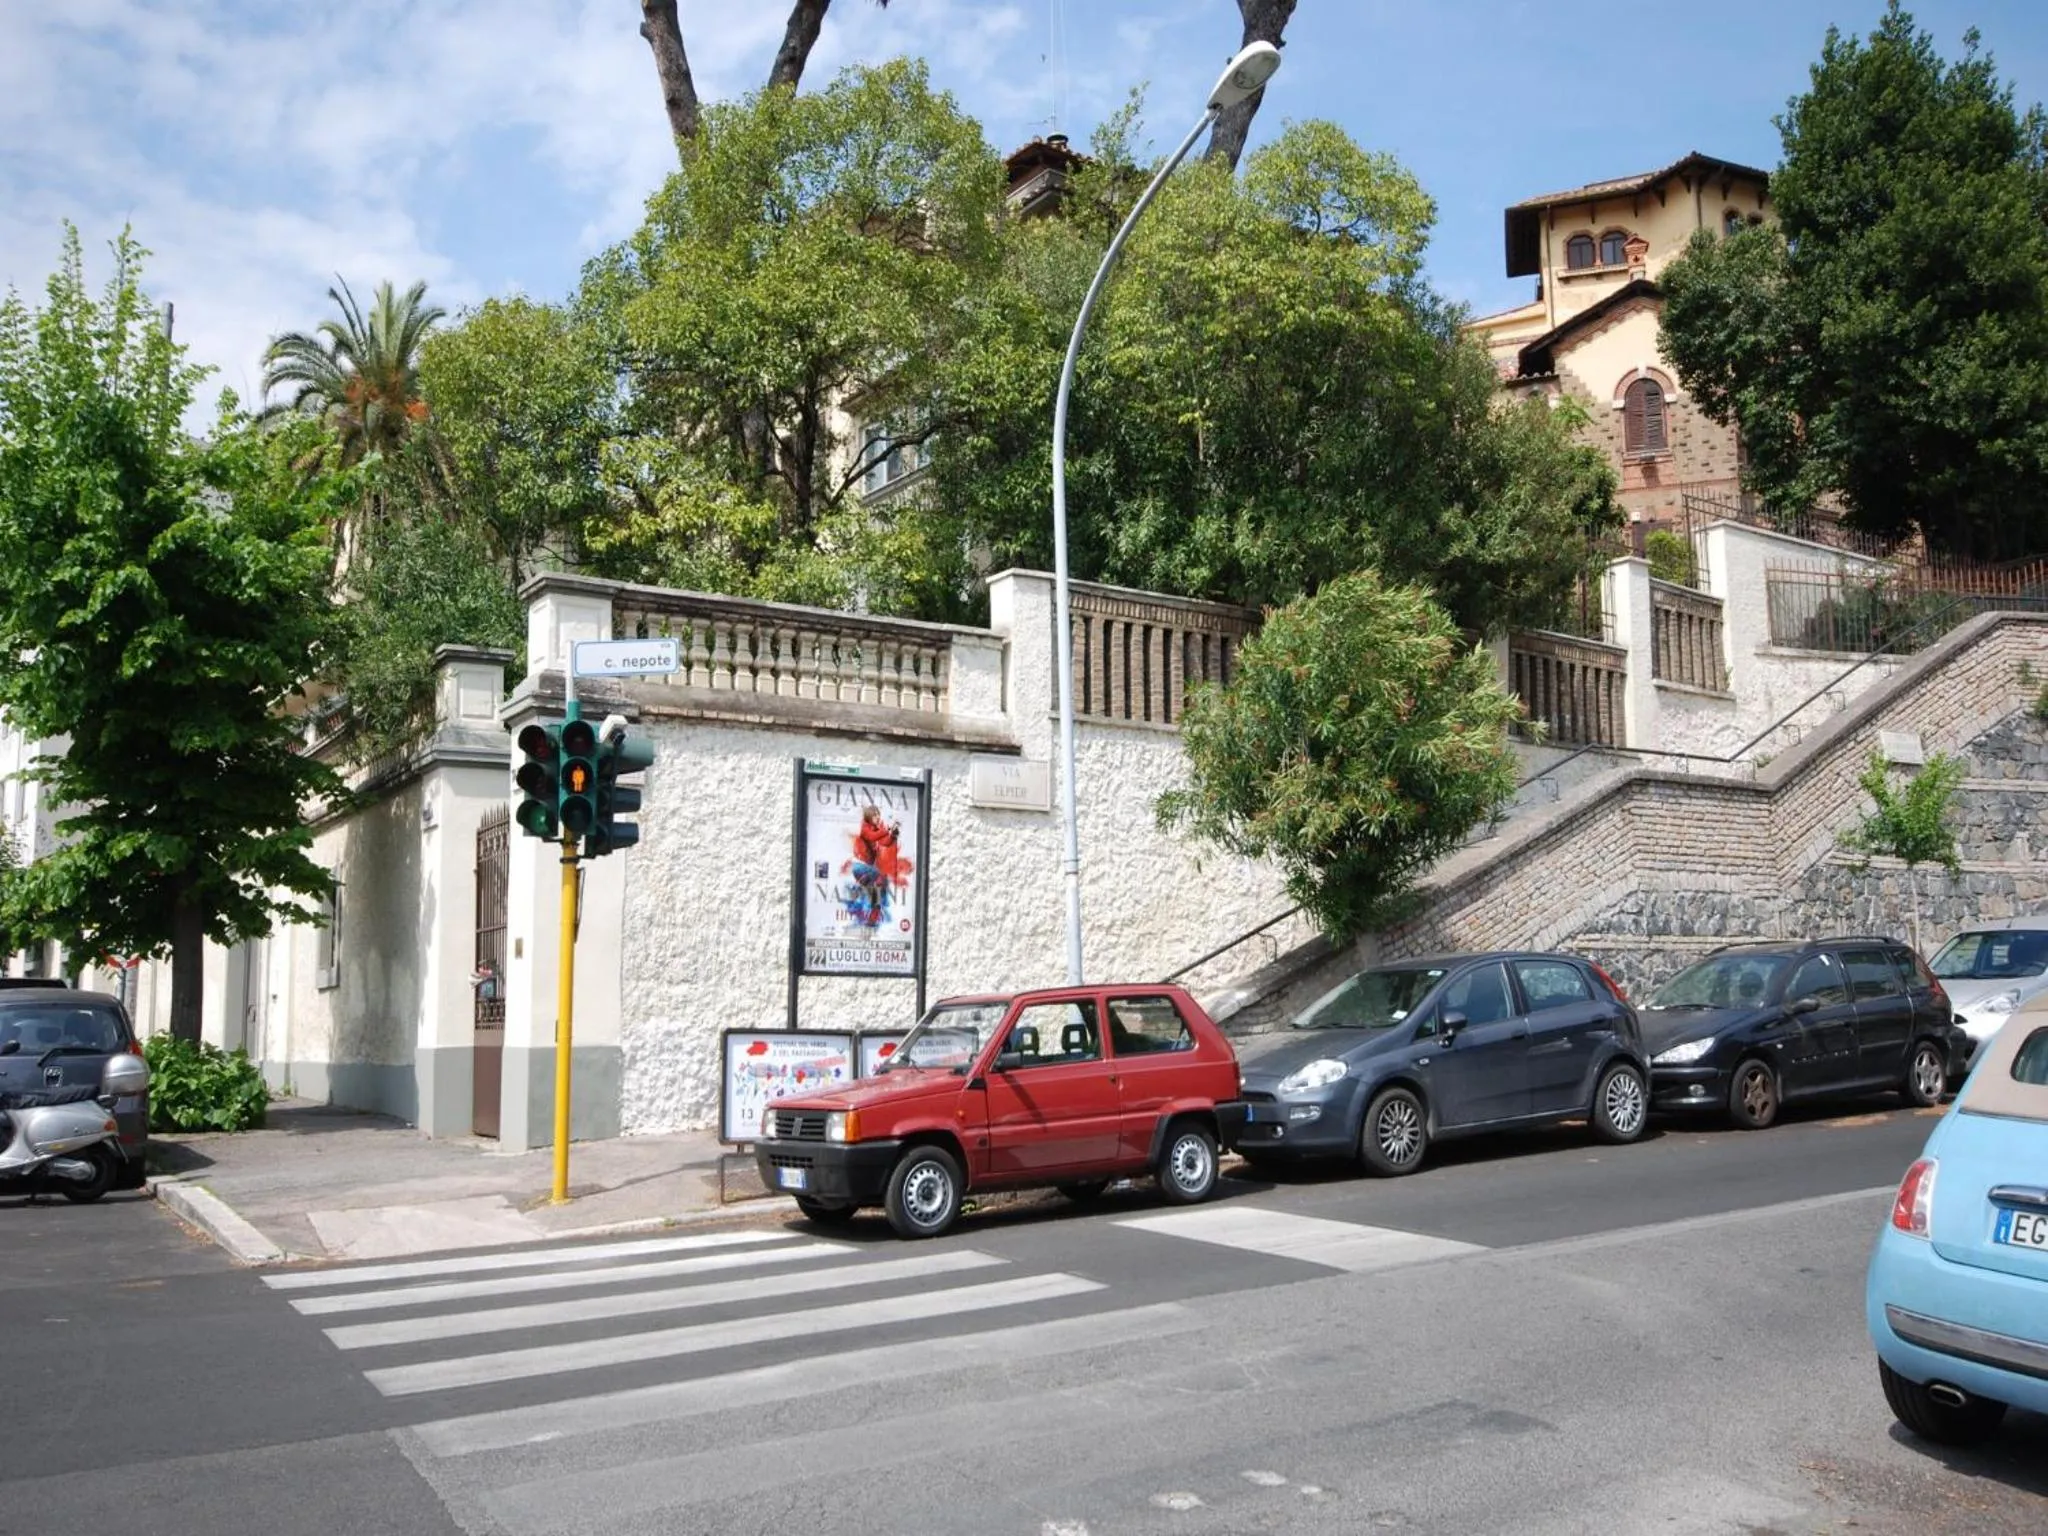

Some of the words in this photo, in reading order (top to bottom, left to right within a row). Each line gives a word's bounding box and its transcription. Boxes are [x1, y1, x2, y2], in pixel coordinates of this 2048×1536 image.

[604, 658, 618, 668] c.
[622, 655, 671, 668] nepote
[1002, 765, 1021, 777] VIA
[816, 782, 909, 811] GIANNA
[814, 883, 907, 906] NAINI
[810, 949, 827, 967] 22
[828, 950, 872, 963] LUGLIO
[875, 951, 908, 964] ROMA
[2013, 1214, 2047, 1244] EG
